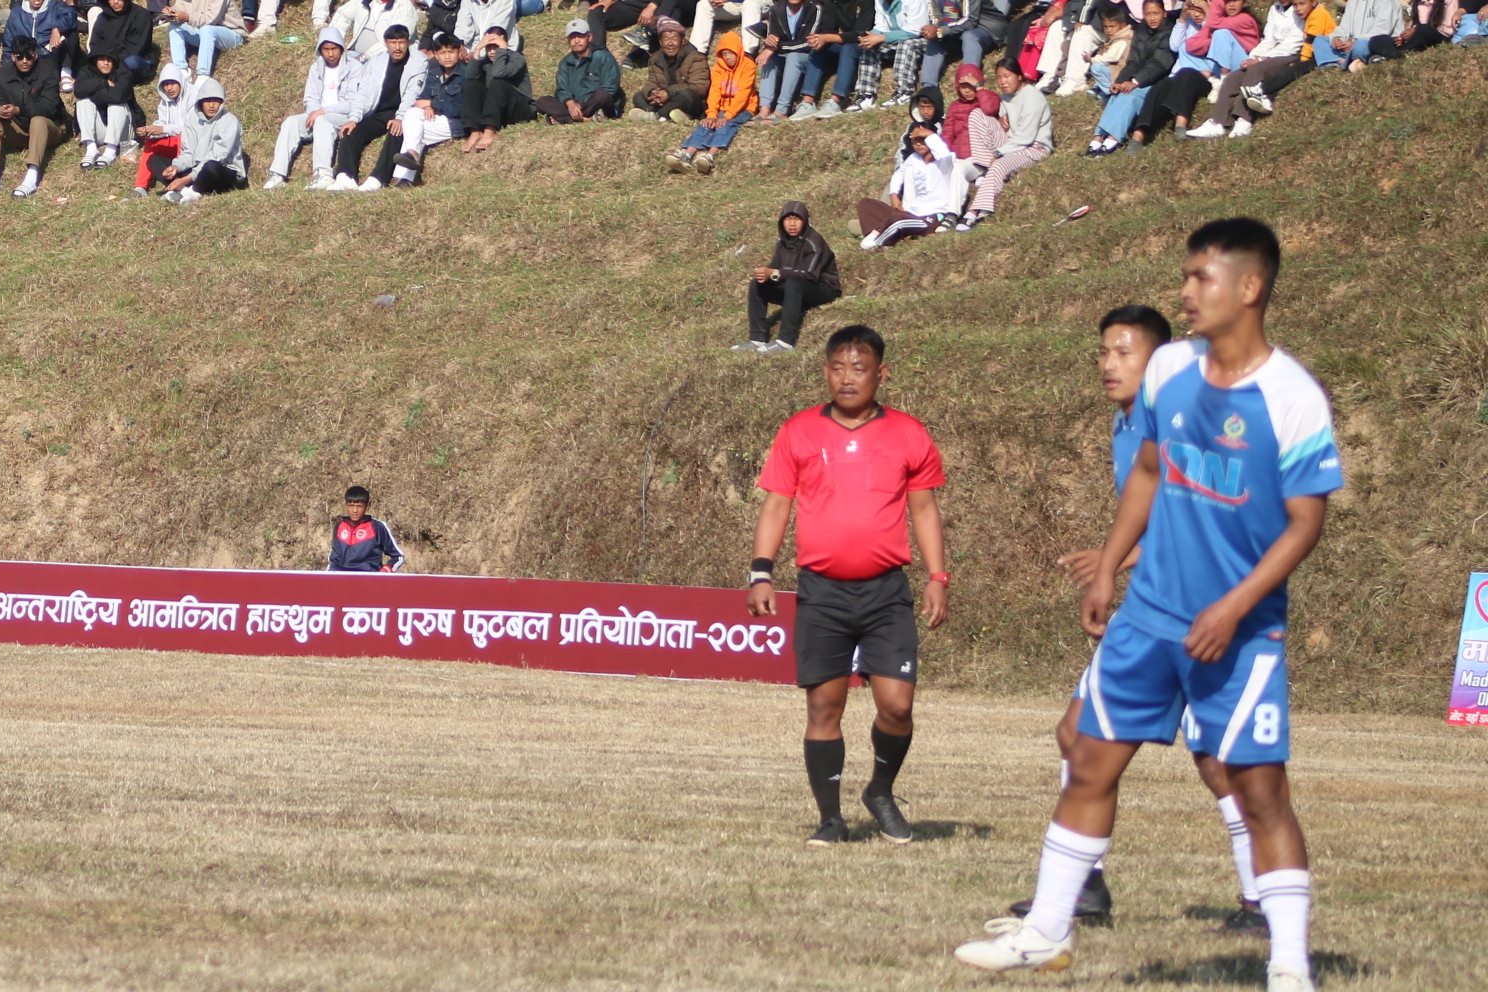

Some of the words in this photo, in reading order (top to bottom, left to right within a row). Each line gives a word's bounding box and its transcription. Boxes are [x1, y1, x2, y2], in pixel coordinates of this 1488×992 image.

[128, 595, 240, 631] आमन्त्रित
[342, 607, 390, 635] कप
[397, 608, 456, 646] पुरुष
[463, 610, 553, 648] फुटबल
[1253, 703, 1280, 745] 8
